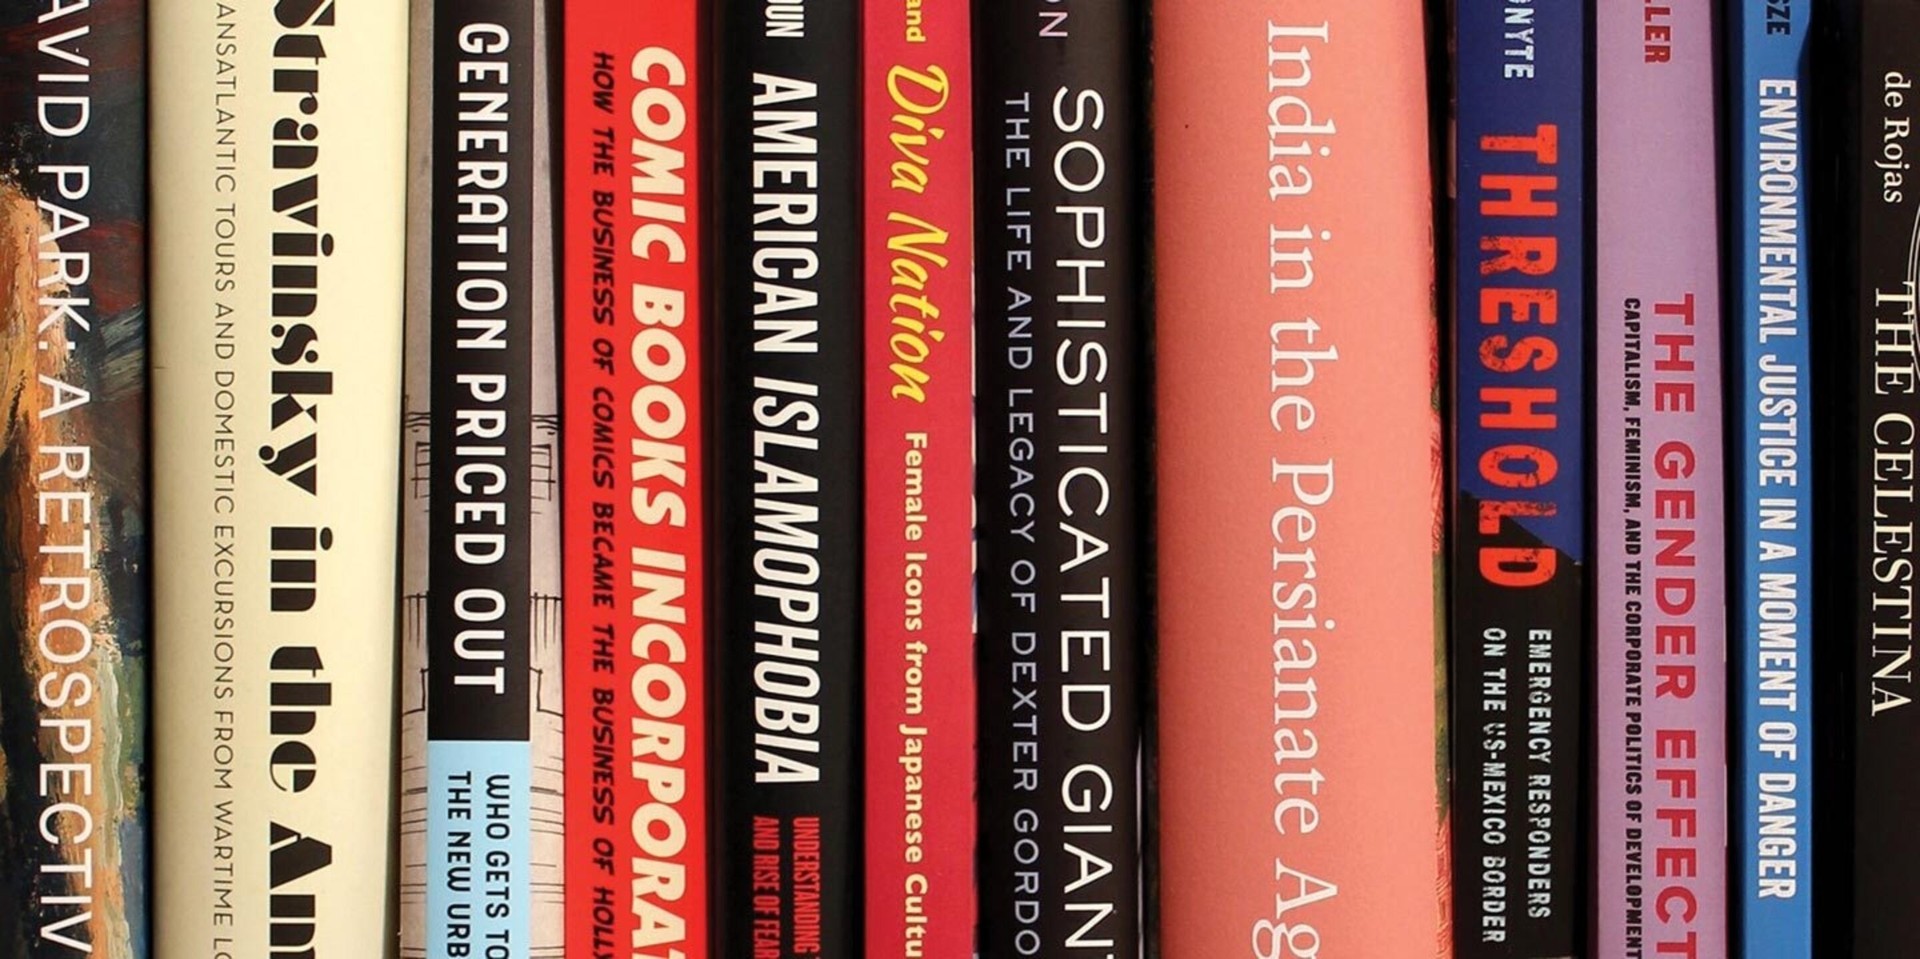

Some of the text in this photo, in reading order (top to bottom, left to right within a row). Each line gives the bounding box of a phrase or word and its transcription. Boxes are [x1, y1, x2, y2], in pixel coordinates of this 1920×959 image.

[592, 52, 615, 113] HOW
[766, 0, 804, 37] UN
[1504, 0, 1534, 78] NYTE
[592, 128, 615, 176] THE
[1267, 20, 1336, 201] India
[1874, 71, 1911, 203] de Rojas
[38, 166, 90, 350] PARK:
[215, 204, 236, 291] TOURS
[592, 190, 615, 325] BUSINESS
[887, 64, 950, 402] Diva Nation
[1270, 224, 1332, 293] in
[39, 374, 90, 419] A
[215, 303, 235, 359] AND
[454, 23, 509, 694] GENERATION PRICED OUT
[592, 338, 615, 375] OF
[1270, 317, 1338, 432] the
[1479, 123, 1559, 587] THRESHOLD
[214, 371, 234, 513] DOMESTIC
[592, 387, 615, 488] COMICS
[753, 73, 820, 783] AMERICAN ISLAMOPHOBIA
[1758, 79, 1797, 898] ENVIRONMENTAL JUSTICE IN A MOMENT OF DANGER
[1871, 281, 1915, 716] THE CELESTINA
[270, 526, 333, 612] in
[592, 502, 615, 608] BECAME
[631, 46, 686, 959] COMIC BOOKS INCORPORA
[1006, 92, 1040, 955] THE LIFE AND LEGACY OF DEXTER GORDO
[1053, 86, 1114, 959] SOPHISTICATED GIAN
[214, 525, 234, 699] EXCURSIONS
[592, 624, 615, 673] THE
[1271, 458, 1336, 834] Persianate
[1623, 298, 1643, 959] CAPITALISM, FEMINISM, AND THE CORPORATE POLITICS OF DEVELOPMENT
[1654, 293, 1697, 959] THE GENDER EFFECT
[39, 446, 92, 953] RETROSPECTIV
[214, 711, 233, 789] FROM
[270, 646, 332, 793] the
[592, 688, 615, 824] BUSINESS
[899, 432, 928, 957] Female Icons from Japanese Cultu
[1482, 628, 1506, 943] ON THE US-MEXICO BORDER
[1527, 629, 1551, 918] EMERGENCY RESPONDERS
[213, 801, 233, 926] WARTIME
[447, 772, 471, 959] THE NEW URB
[485, 774, 510, 959] WHO GETS TO
[592, 838, 615, 874] OF
[753, 816, 779, 959] AND RISE OF FEAR
[793, 817, 820, 953] UNDERSTANDING
